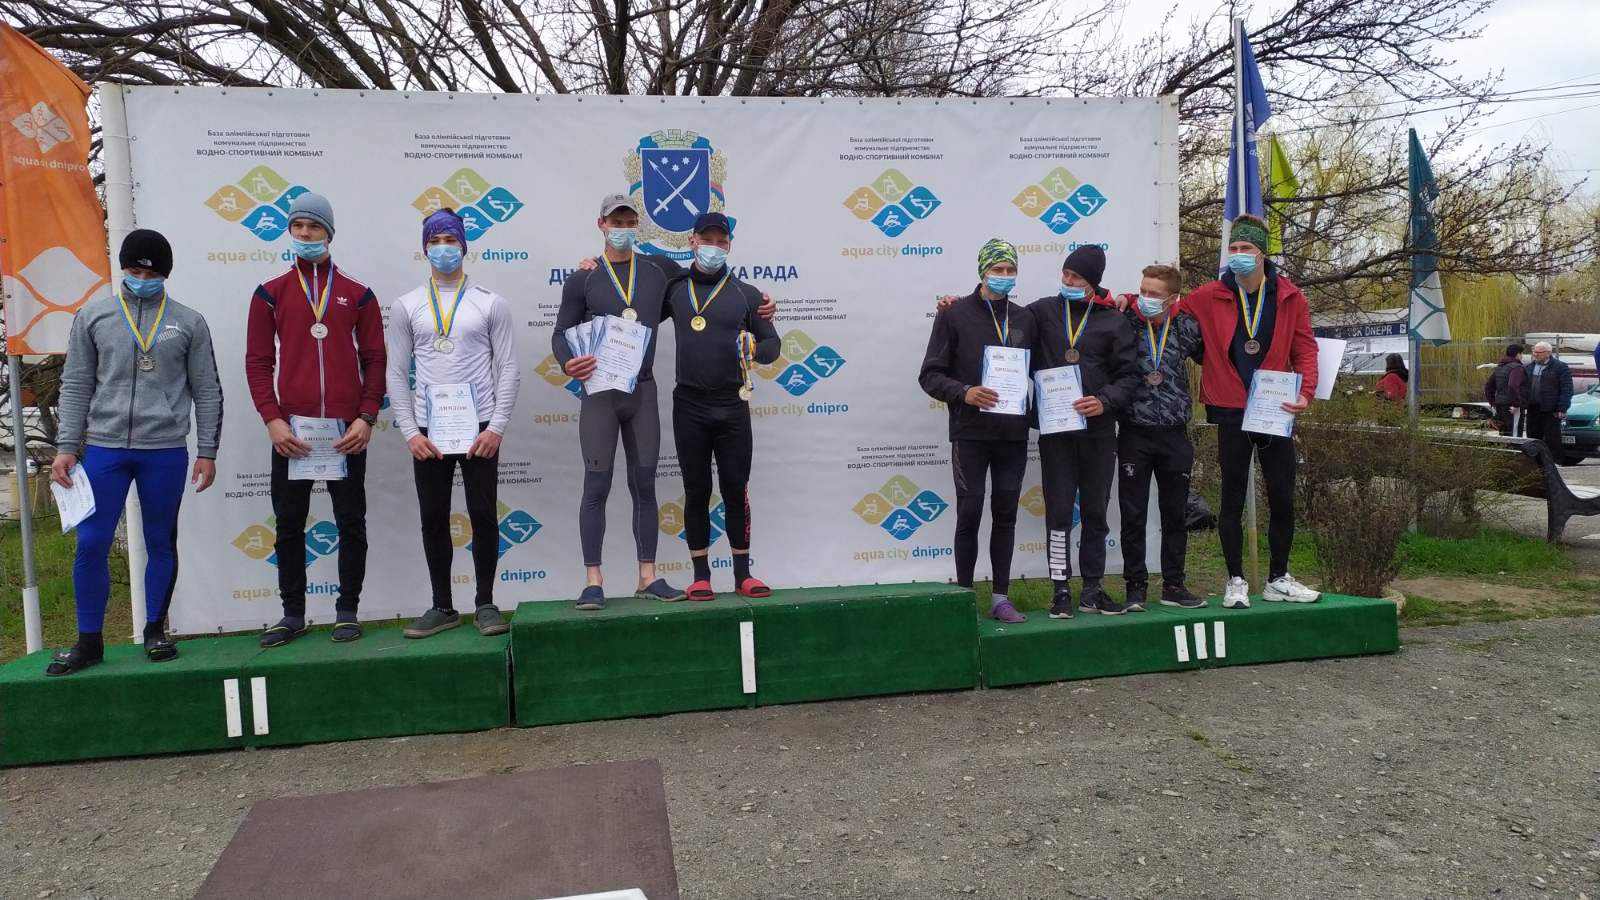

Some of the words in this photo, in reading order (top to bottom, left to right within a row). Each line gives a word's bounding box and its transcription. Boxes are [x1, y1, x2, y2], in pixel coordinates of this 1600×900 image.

[225, 130, 270, 138] олімпійської
[214, 140, 256, 148] комунальне
[258, 140, 306, 148] підприємство
[196, 148, 282, 156] ВОДНО-СПОРТИВНИЙ
[49, 160, 86, 172] dnipro
[841, 247, 873, 259] aqua
[876, 244, 898, 258] city
[902, 244, 943, 258] dnipro
[1044, 241, 1065, 254] city
[208, 251, 246, 264] aqua
[249, 249, 278, 264] city
[482, 248, 528, 262] dnipro
[754, 264, 798, 280] РАДА
[1365, 324, 1392, 336] DNEPR
[779, 403, 804, 416] city
[807, 403, 848, 415] dnipro
[534, 414, 568, 426] aqua
[848, 460, 915, 469] ВОДНО-СПОРТИВНИЙ
[854, 550, 884, 562] aqua
[887, 547, 909, 560] city
[912, 546, 952, 559] dnipro
[658, 561, 682, 574] qua
[500, 569, 546, 583] dnipro
[232, 588, 272, 601] aqua
